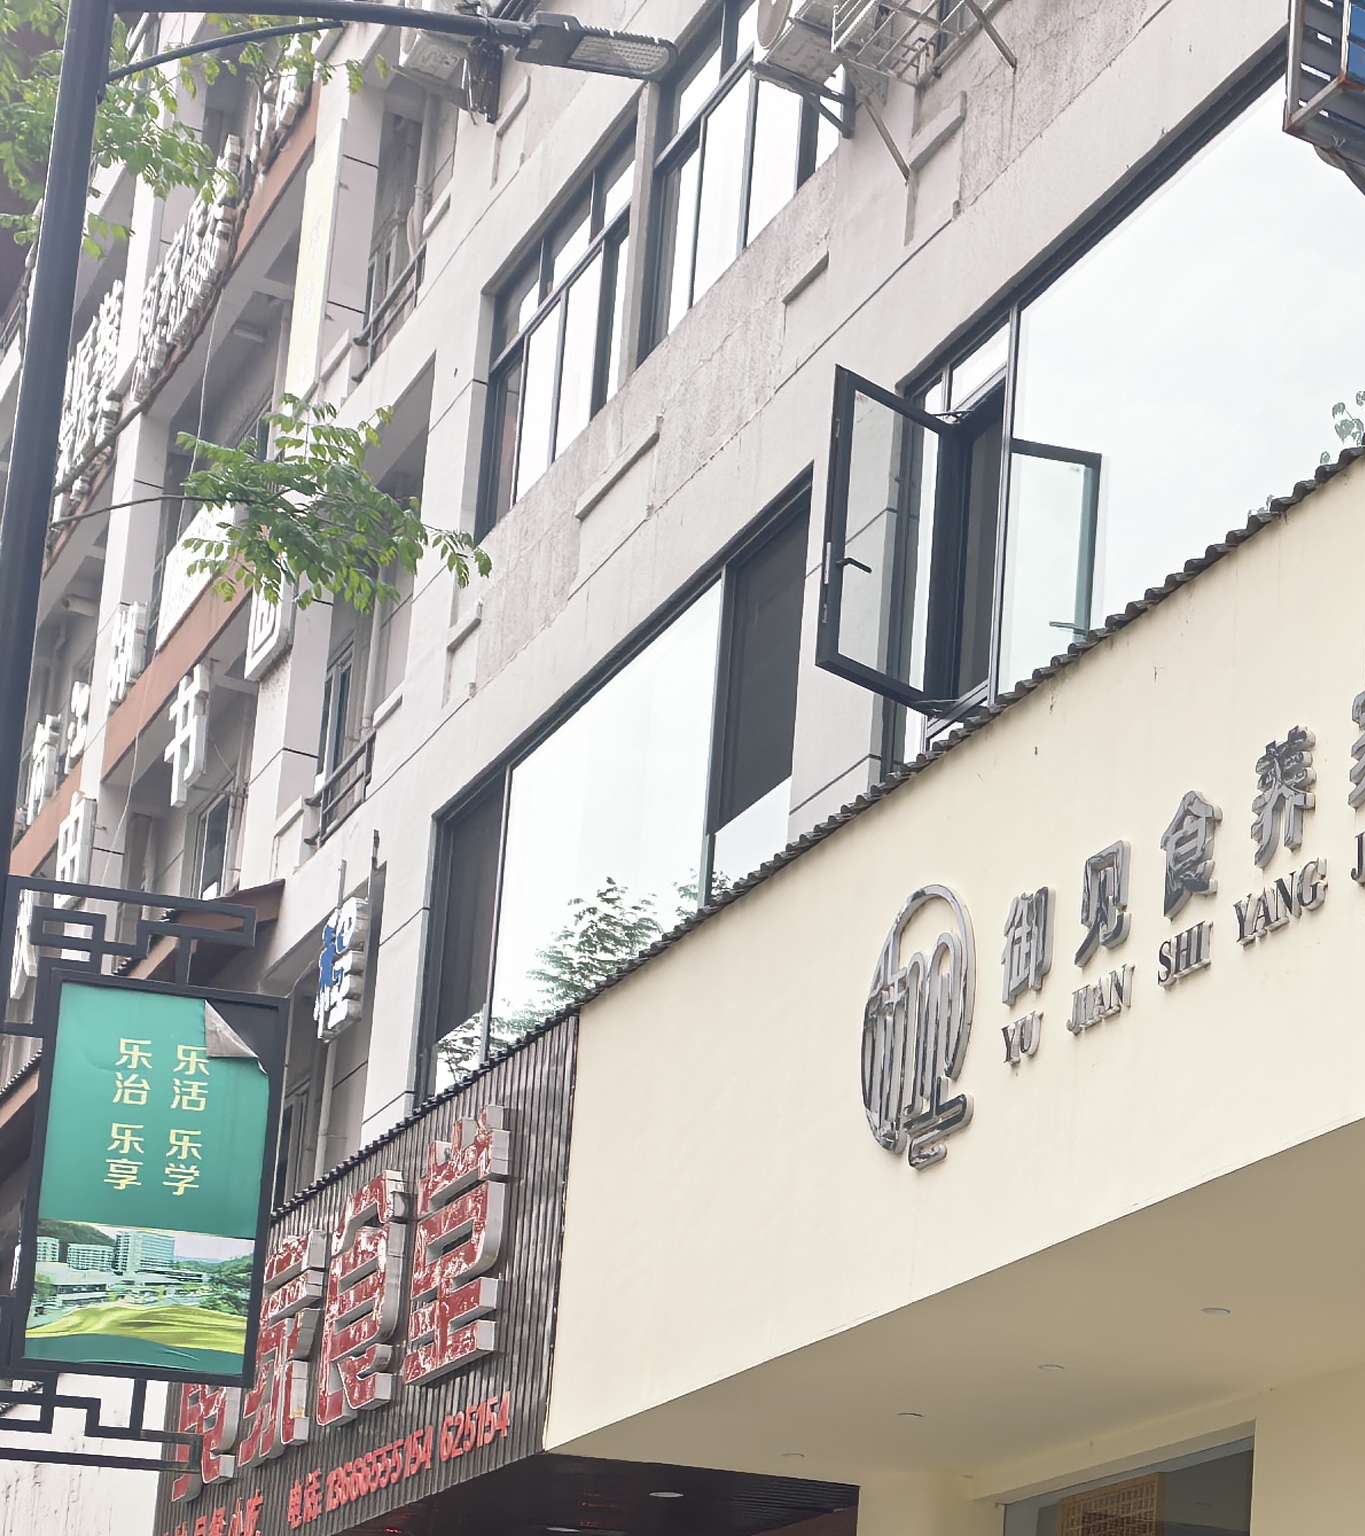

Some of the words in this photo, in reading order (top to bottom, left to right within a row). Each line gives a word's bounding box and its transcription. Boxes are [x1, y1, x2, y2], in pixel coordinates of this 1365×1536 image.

[1000, 1010, 1045, 1069] YU
[1066, 962, 1136, 1038] JIAN
[1157, 919, 1216, 990] SHI
[1232, 856, 1330, 947] YANG
[112, 1036, 154, 1108] 乐治
[170, 1042, 211, 1114] 乐活
[102, 1121, 147, 1193] 乐享
[161, 1127, 204, 1198] 乐学
[439, 1390, 512, 1463] 625154
